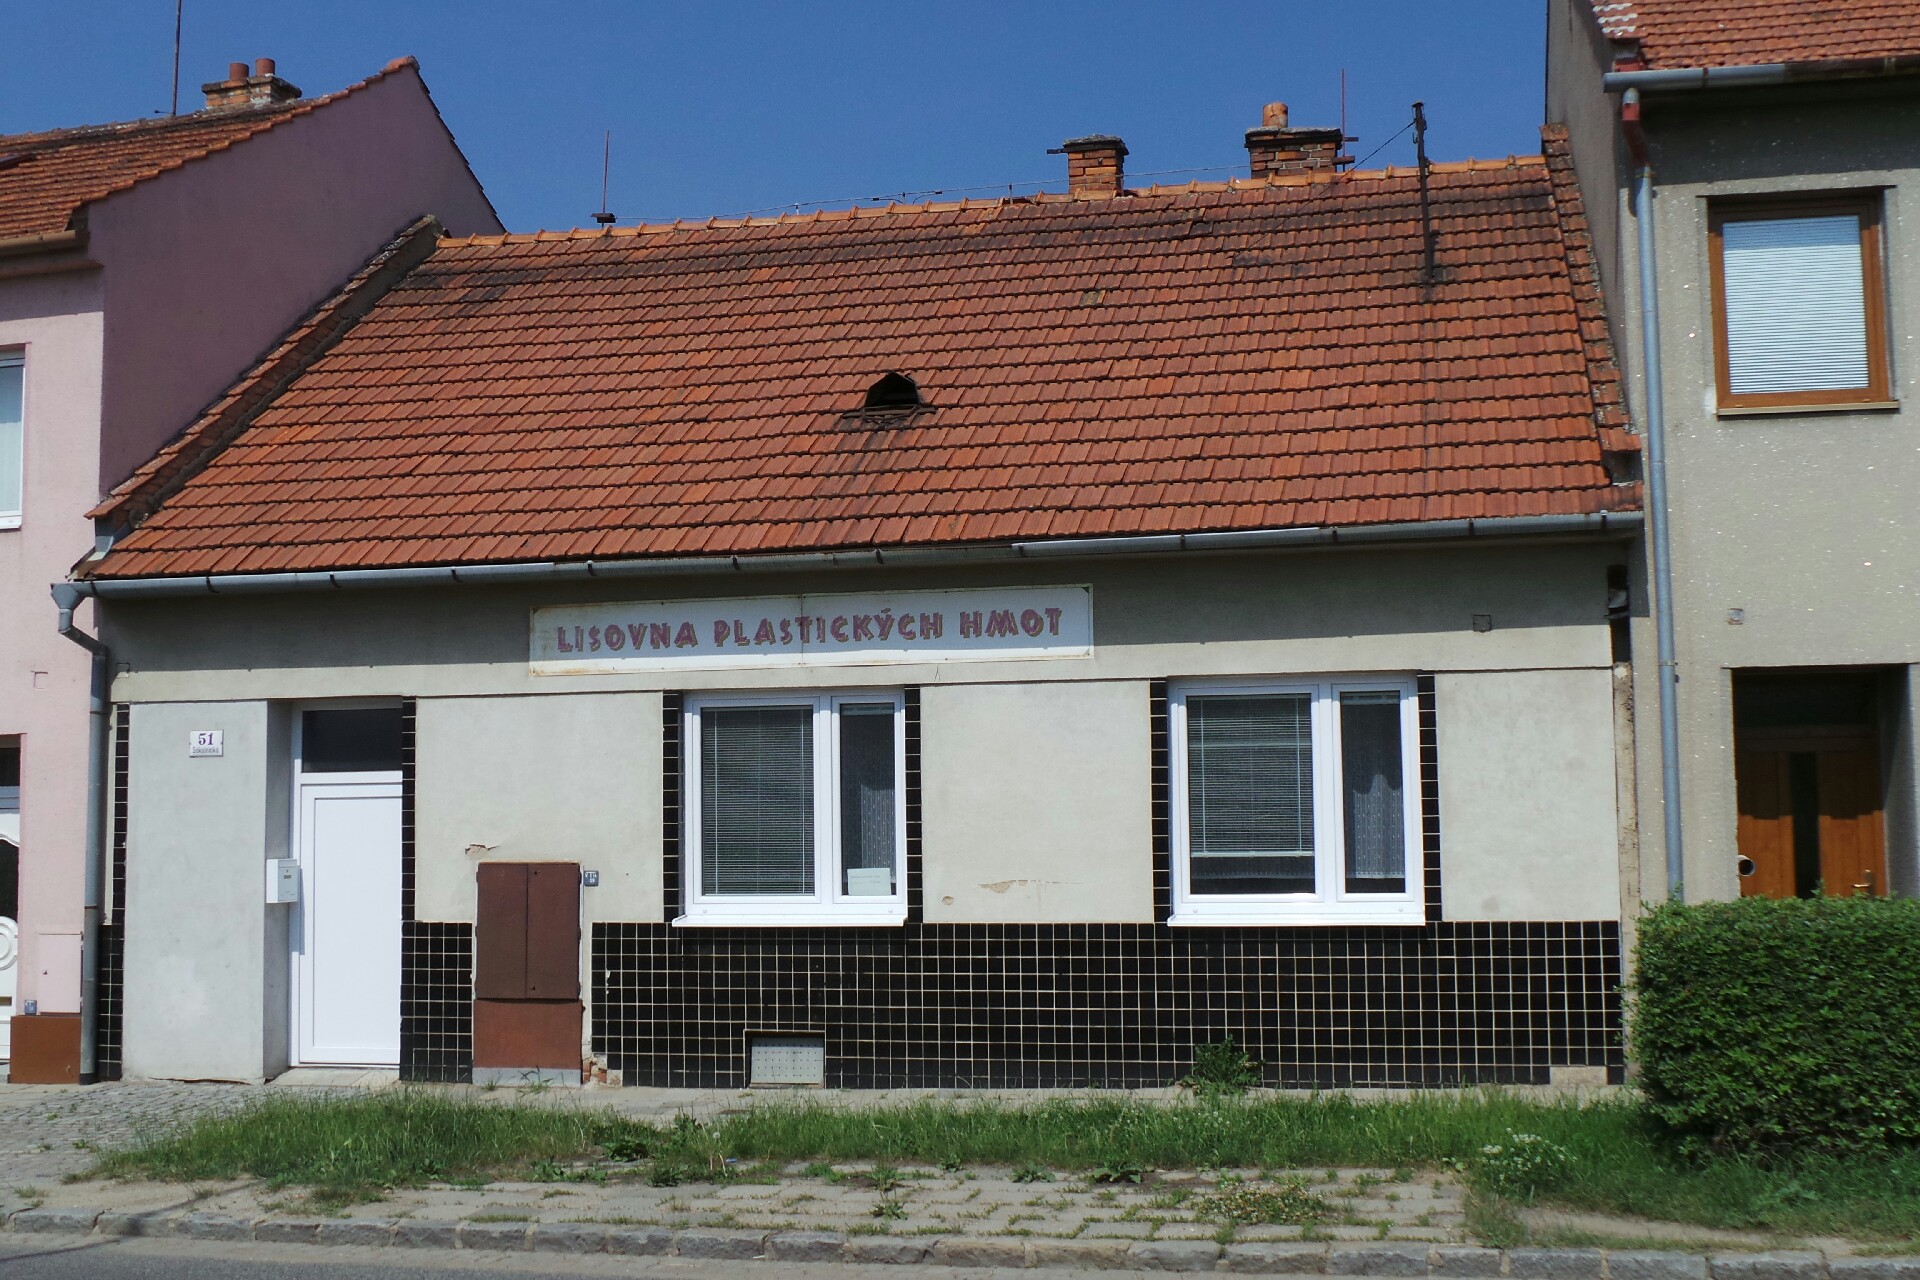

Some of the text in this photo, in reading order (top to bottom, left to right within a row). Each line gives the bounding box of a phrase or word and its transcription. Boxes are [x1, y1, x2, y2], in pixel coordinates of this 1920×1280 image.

[557, 607, 1063, 652] LISOVNA PLASTICKÝCH HMOT
[198, 732, 213, 745] 51
